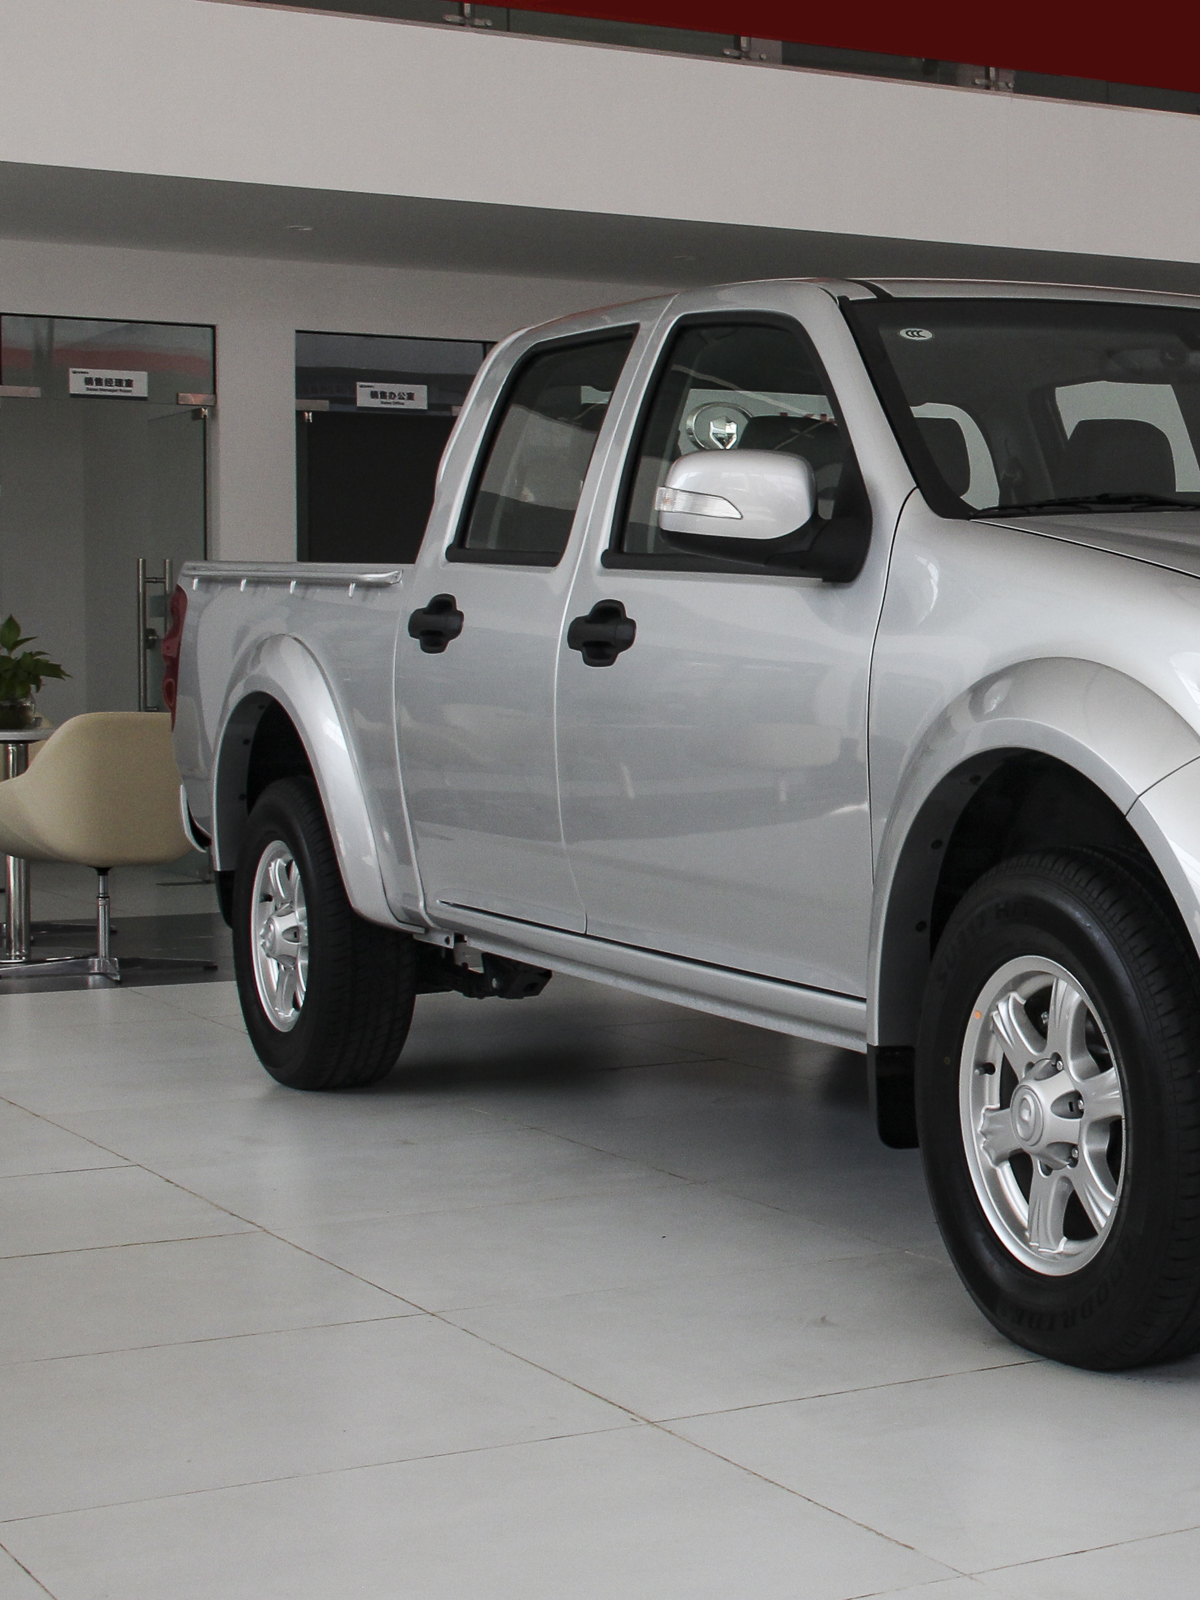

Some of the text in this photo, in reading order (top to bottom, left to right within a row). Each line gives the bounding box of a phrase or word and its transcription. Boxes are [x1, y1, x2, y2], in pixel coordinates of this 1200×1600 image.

[84, 376, 134, 388] 销售经理室
[370, 390, 415, 401] 销售办公室
